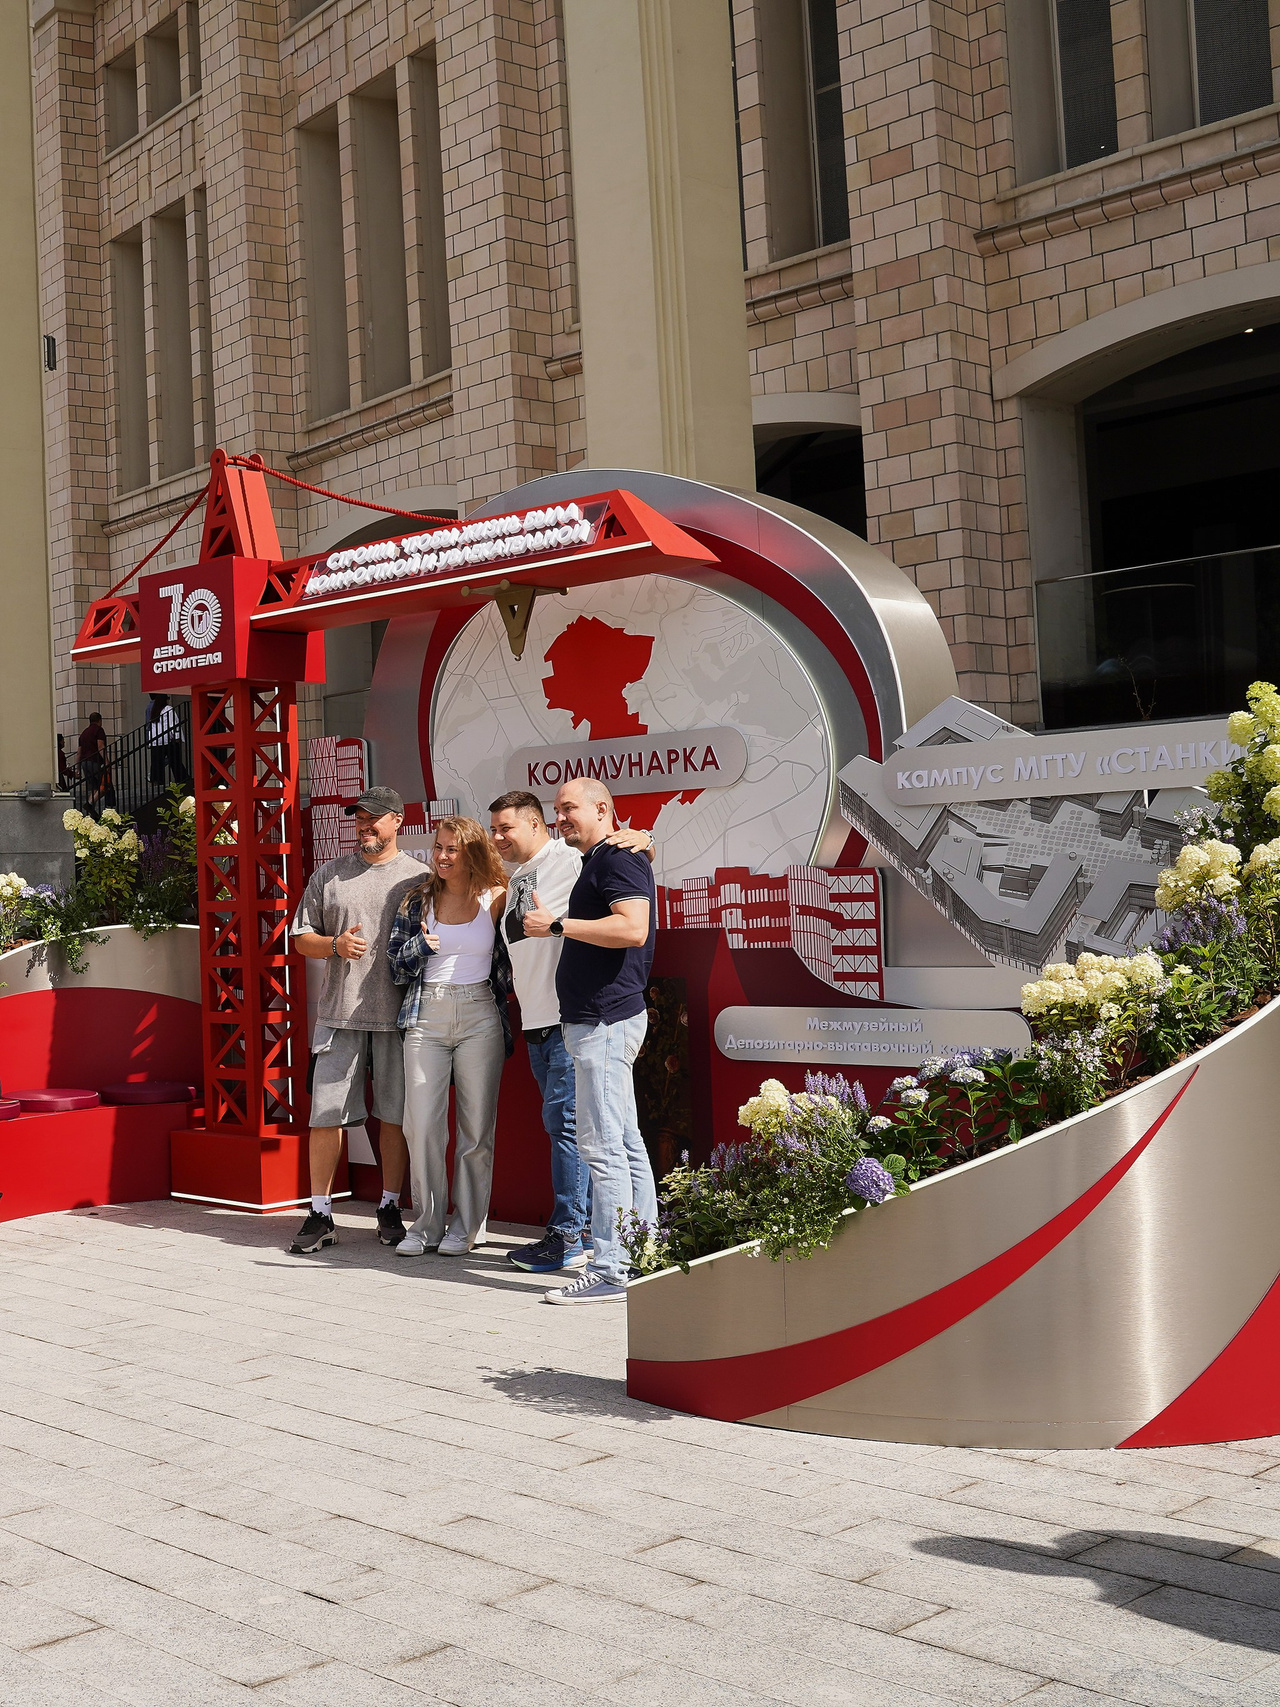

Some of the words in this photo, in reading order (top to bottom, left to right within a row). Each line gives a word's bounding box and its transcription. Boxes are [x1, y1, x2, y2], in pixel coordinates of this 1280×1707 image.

[523, 502, 583, 531] БЫЛА
[305, 553, 422, 595] КОМФОРТНОЙ
[436, 519, 591, 570] УВЛЕКАТЕЛЬНОЙ
[159, 584, 222, 649] 70
[153, 644, 185, 659] ДЕНЬ
[153, 652, 222, 674] СТРОИТЕЛЯ
[527, 745, 722, 787] КОММУНАРКА
[896, 762, 1005, 790] кампус
[1013, 751, 1087, 782] МГТУ
[1096, 740, 1249, 776] «СТАНКИ
[806, 1016, 925, 1035] Межмузейный
[725, 1034, 934, 1056] Депозитарно-выставочный
